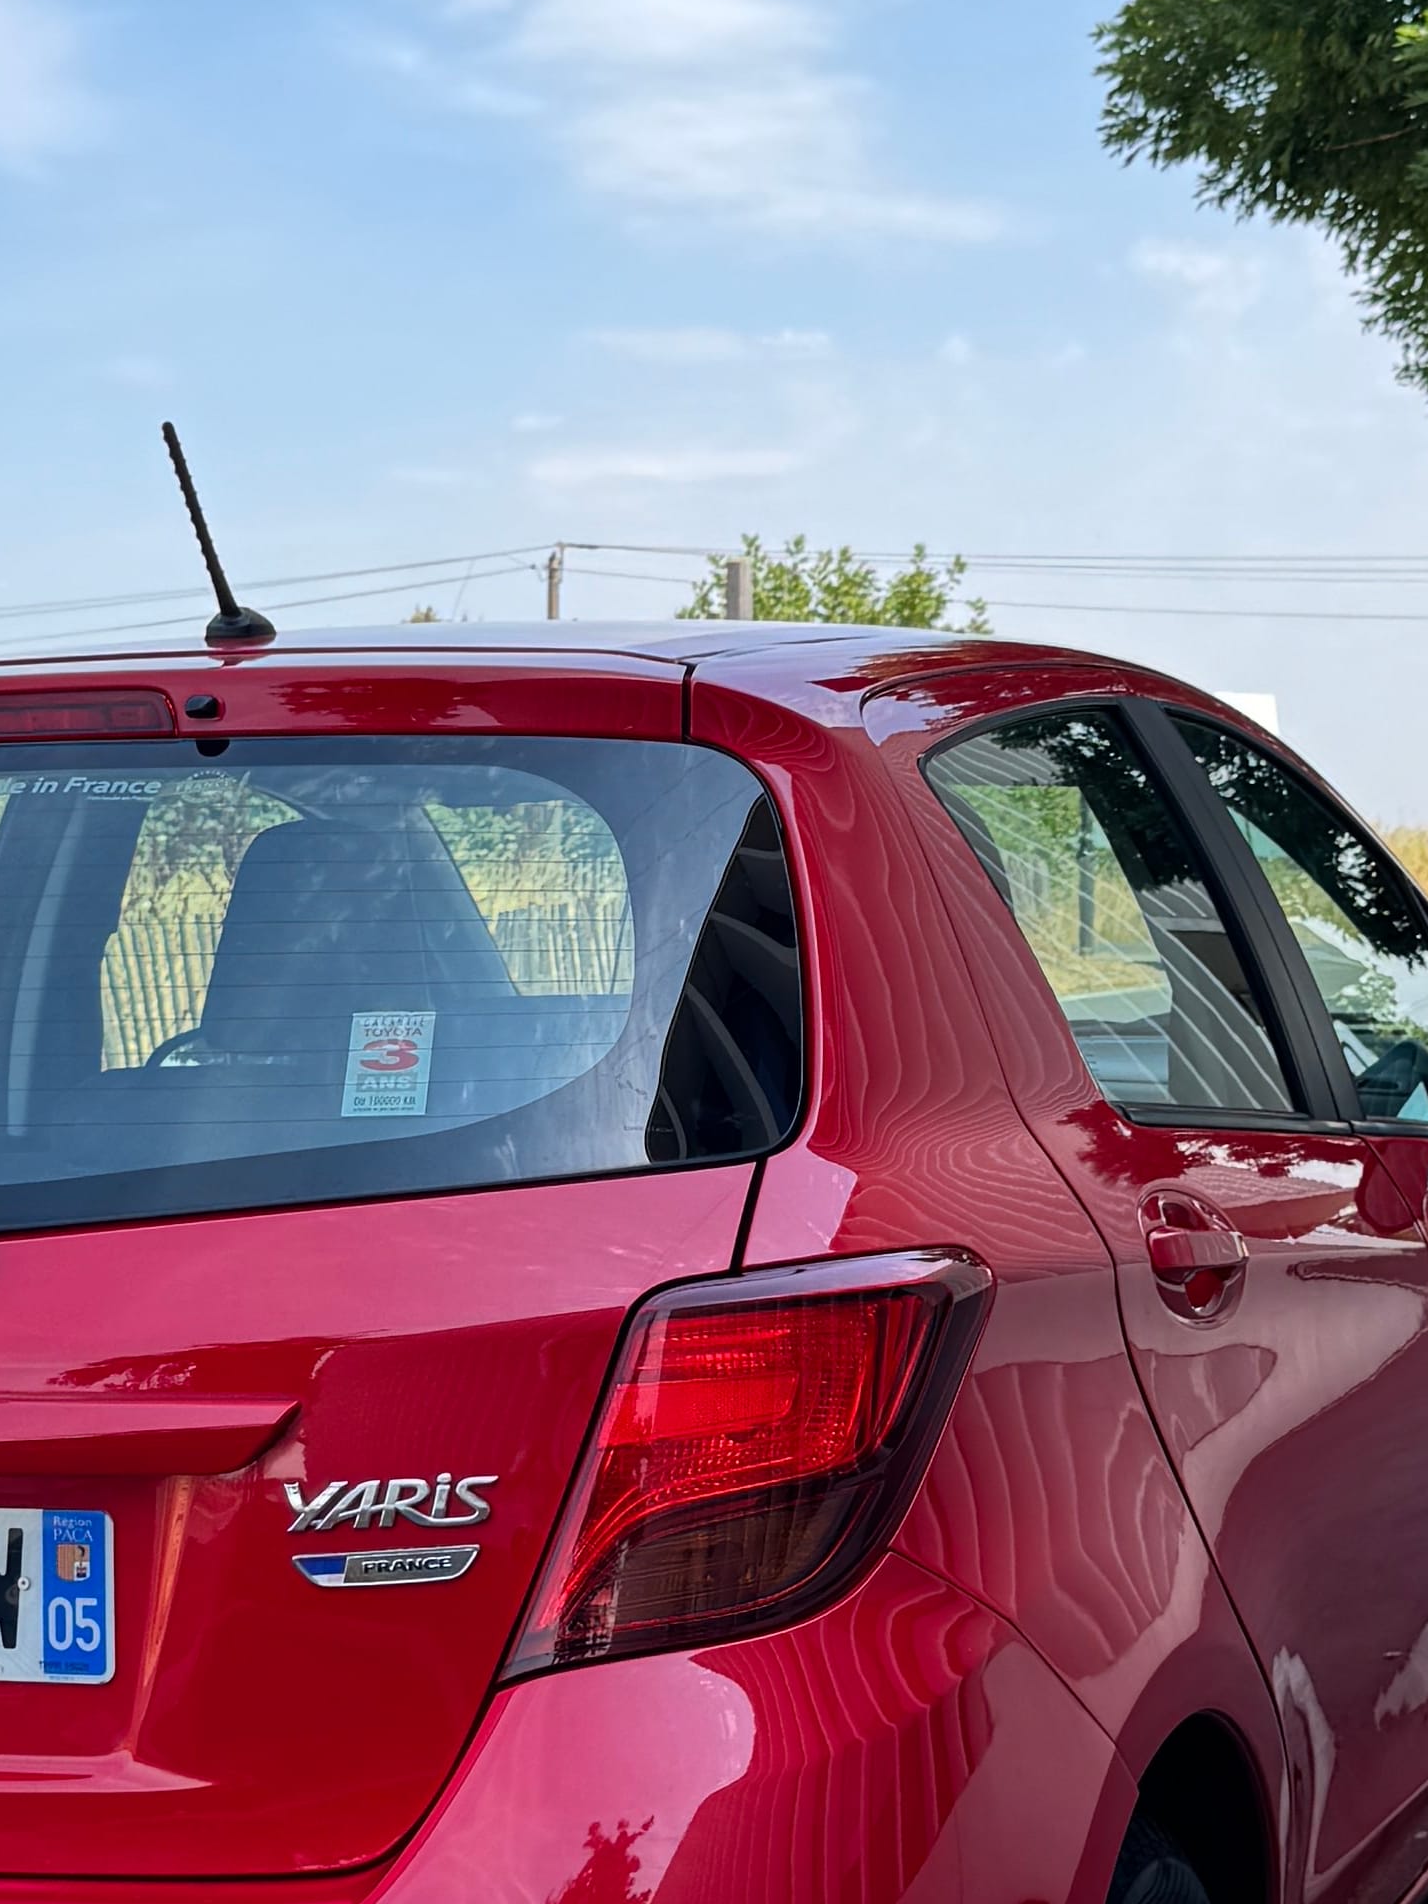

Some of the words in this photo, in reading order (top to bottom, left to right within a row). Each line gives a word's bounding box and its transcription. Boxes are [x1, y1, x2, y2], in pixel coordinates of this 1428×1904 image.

[31, 778, 60, 794] in
[64, 776, 162, 794] France
[363, 1027, 423, 1037] TOYOTA
[359, 1039, 420, 1071] 3
[361, 1076, 413, 1090] ANS
[53, 1529, 94, 1542] PACA
[361, 1555, 452, 1575] FRANCE
[48, 1597, 101, 1652] 05
